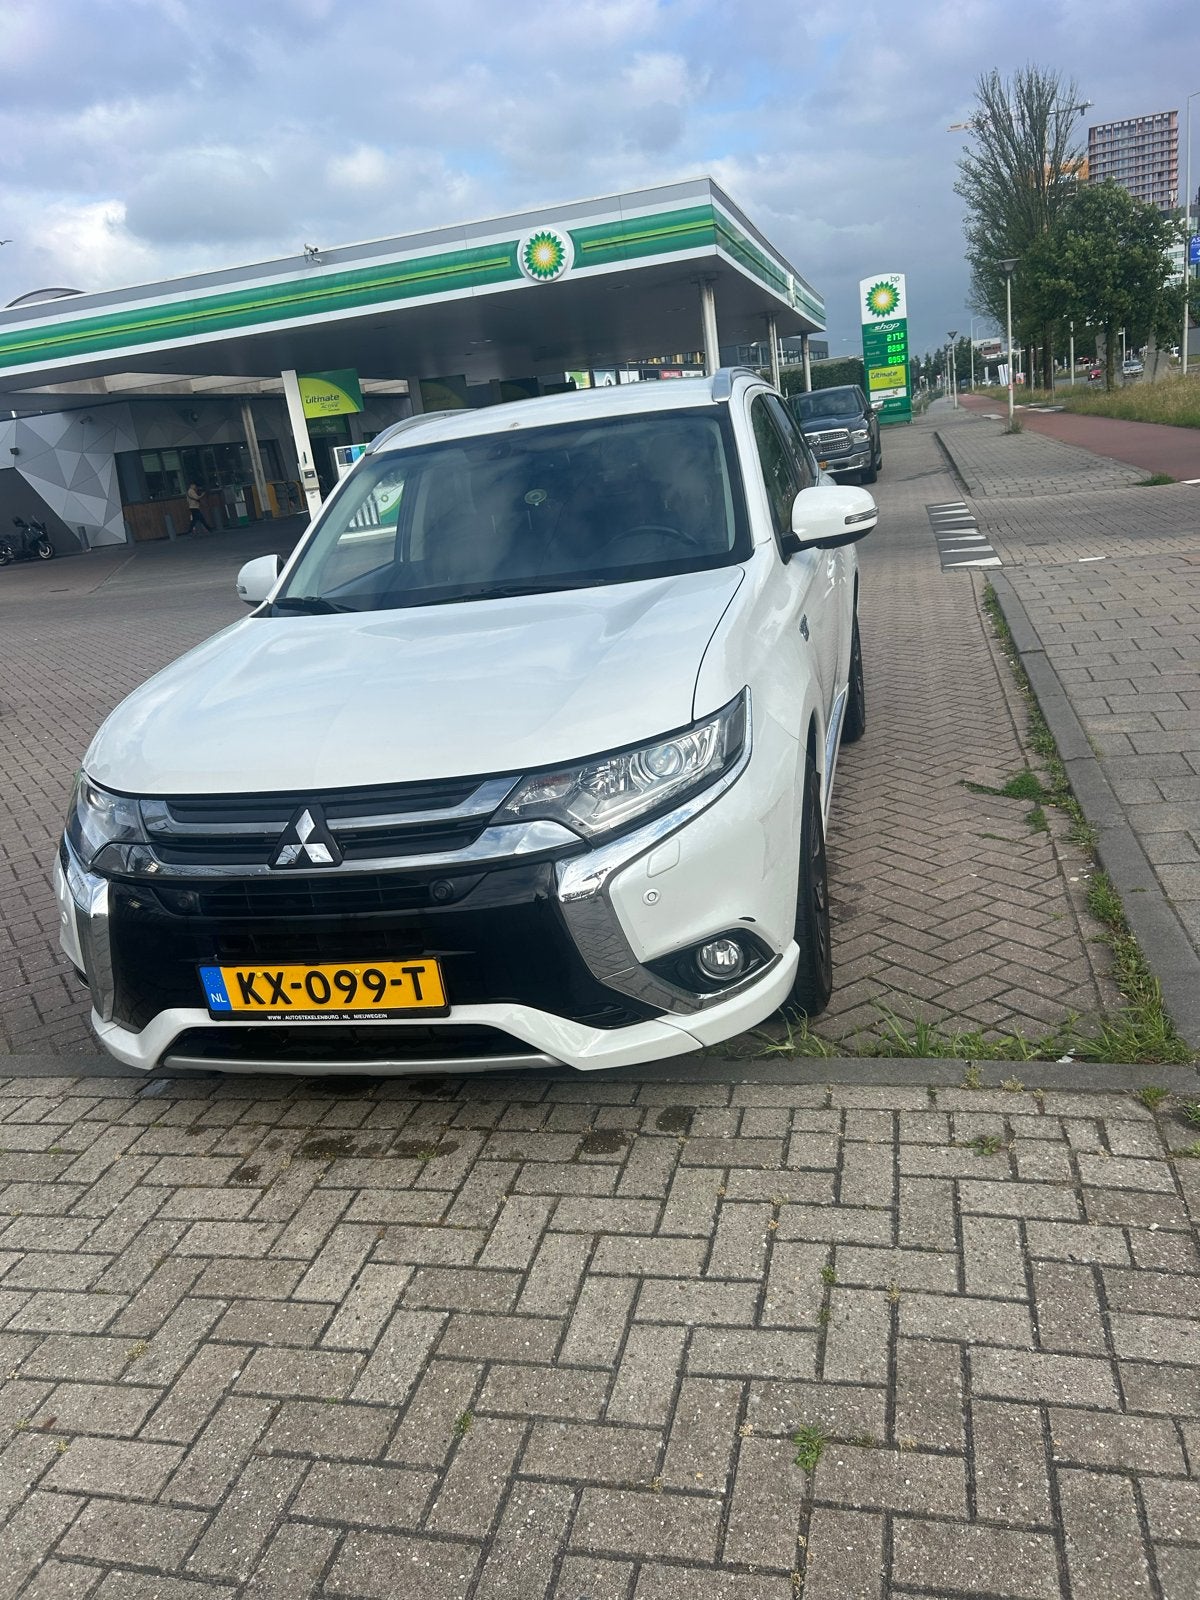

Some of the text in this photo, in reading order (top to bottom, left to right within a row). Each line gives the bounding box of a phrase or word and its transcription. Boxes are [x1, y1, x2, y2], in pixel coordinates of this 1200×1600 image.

[890, 275, 900, 283] bp
[874, 322, 900, 331] shop
[305, 394, 339, 404] ultimate
[236, 966, 425, 1005] KX-099-T
[210, 992, 227, 1003] NL
